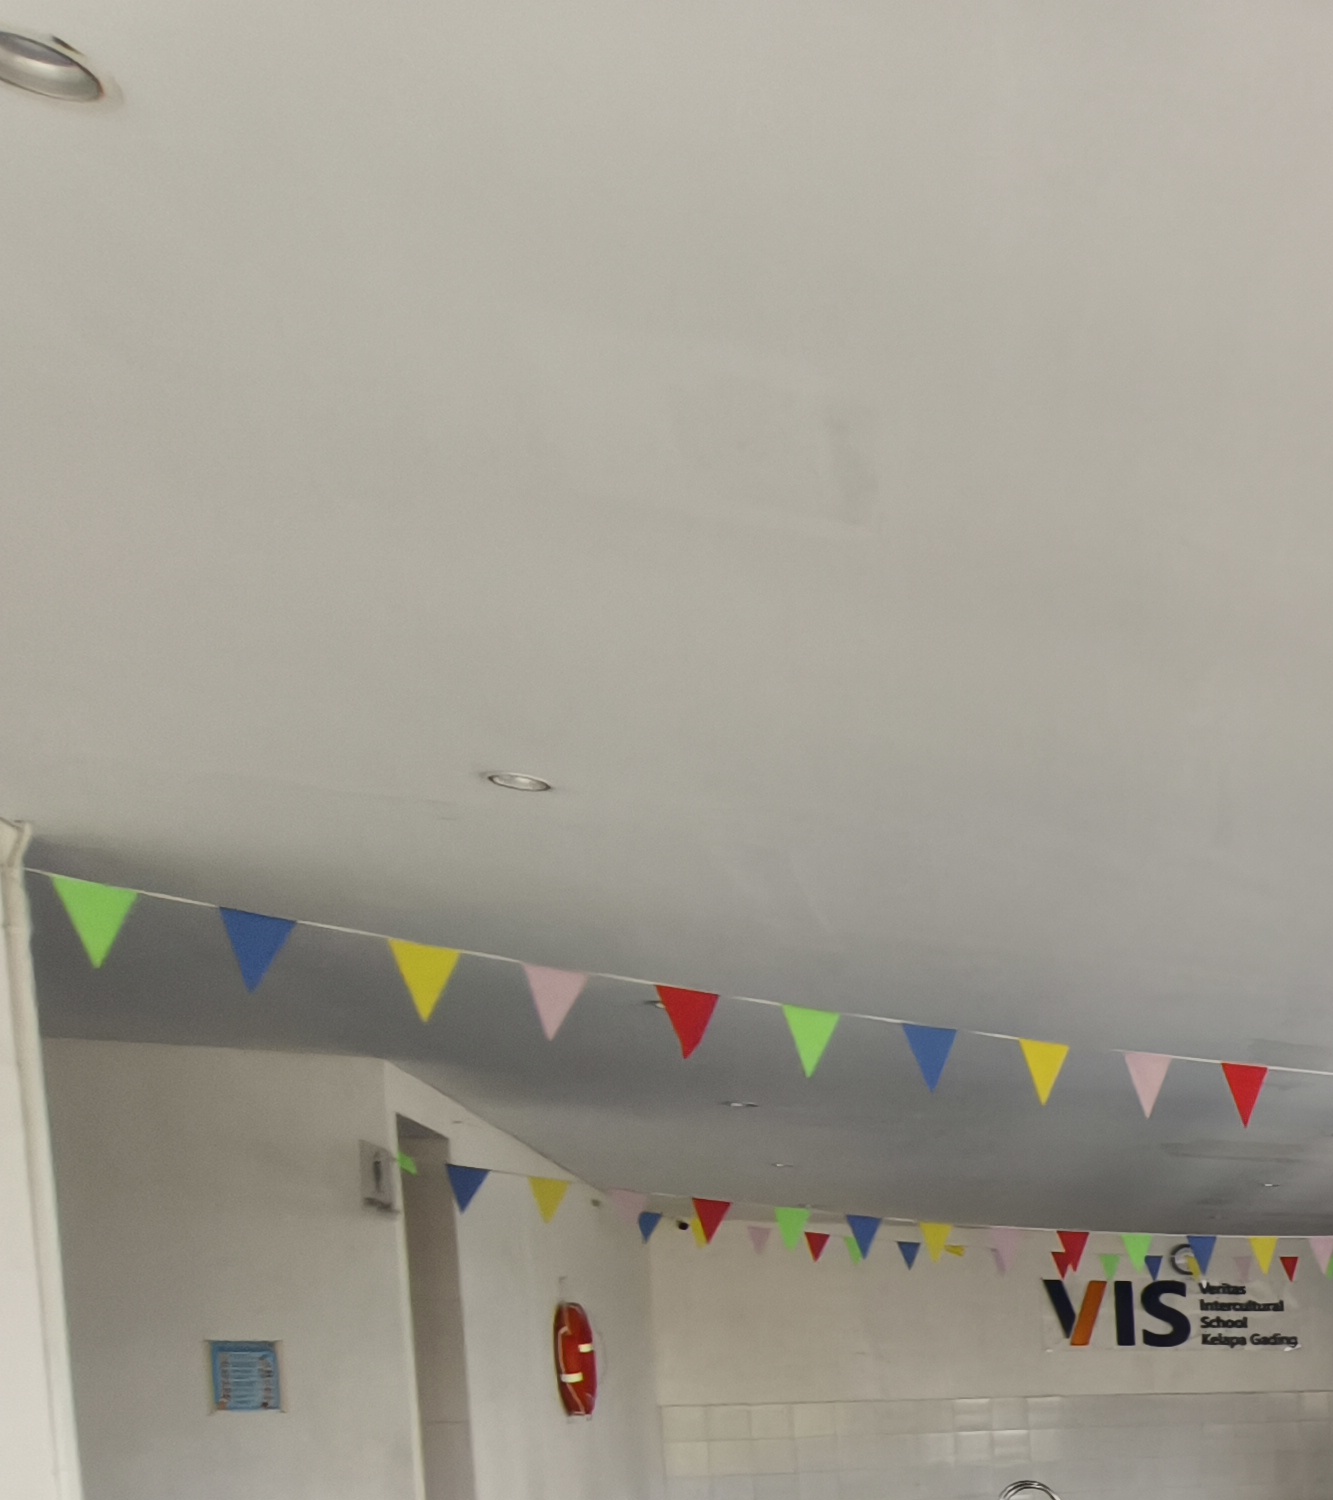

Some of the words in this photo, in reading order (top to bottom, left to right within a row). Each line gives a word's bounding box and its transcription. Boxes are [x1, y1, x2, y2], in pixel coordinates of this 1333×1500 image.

[1199, 1282, 1247, 1295] Veritas
[1042, 1279, 1191, 1348] VIS
[1200, 1316, 1248, 1329] School
[1201, 1333, 1247, 1348] Kelapa
[1250, 1332, 1298, 1348] Gading
